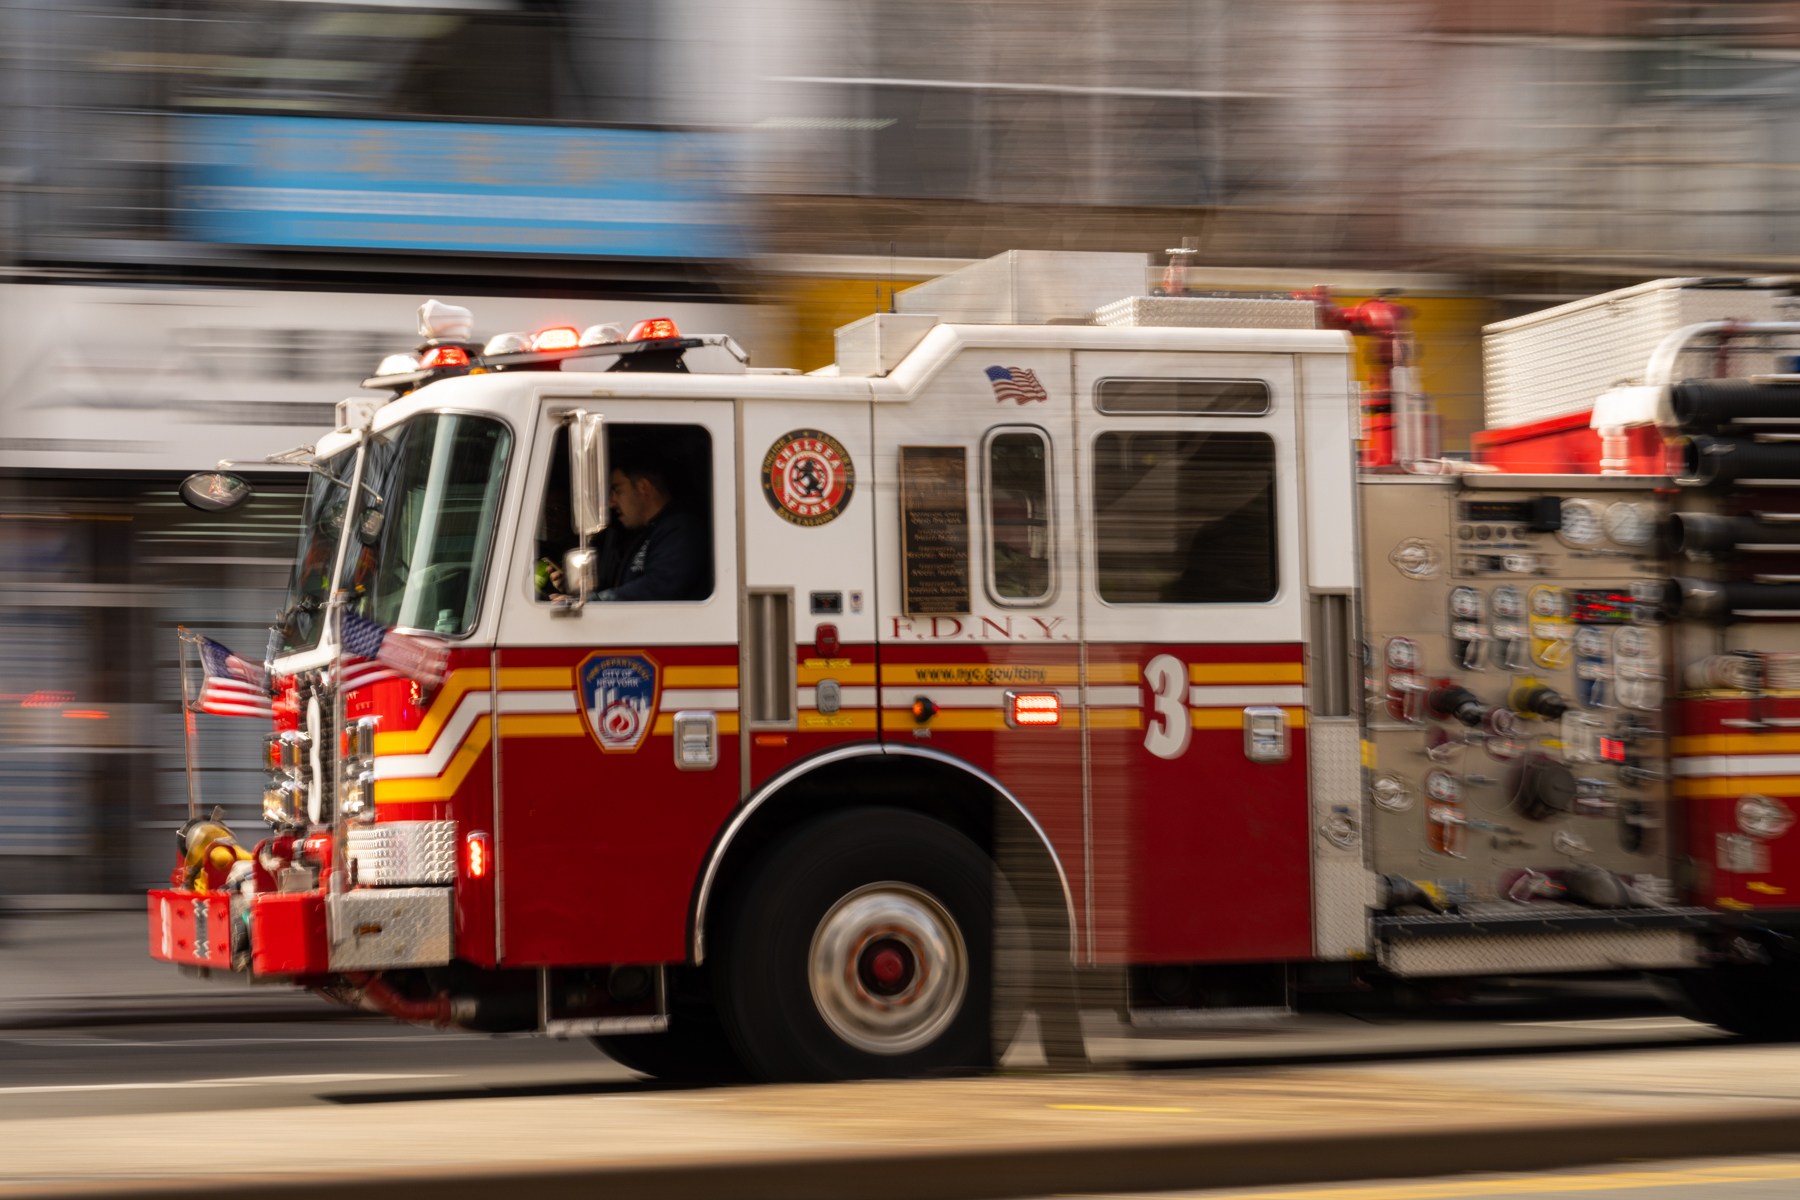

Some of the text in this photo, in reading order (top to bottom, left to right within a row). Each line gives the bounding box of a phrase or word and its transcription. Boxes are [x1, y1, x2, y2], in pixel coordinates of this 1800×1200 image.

[775, 440, 841, 470] CHELSEA
[787, 499, 832, 516] FDNY
[888, 615, 1071, 640] F.D.N.Y.
[597, 678, 639, 688] NEW YORK
[602, 668, 634, 678] CITY OF
[915, 665, 1047, 685] www.nyc.gov/fdny
[1143, 653, 1191, 760] 3
